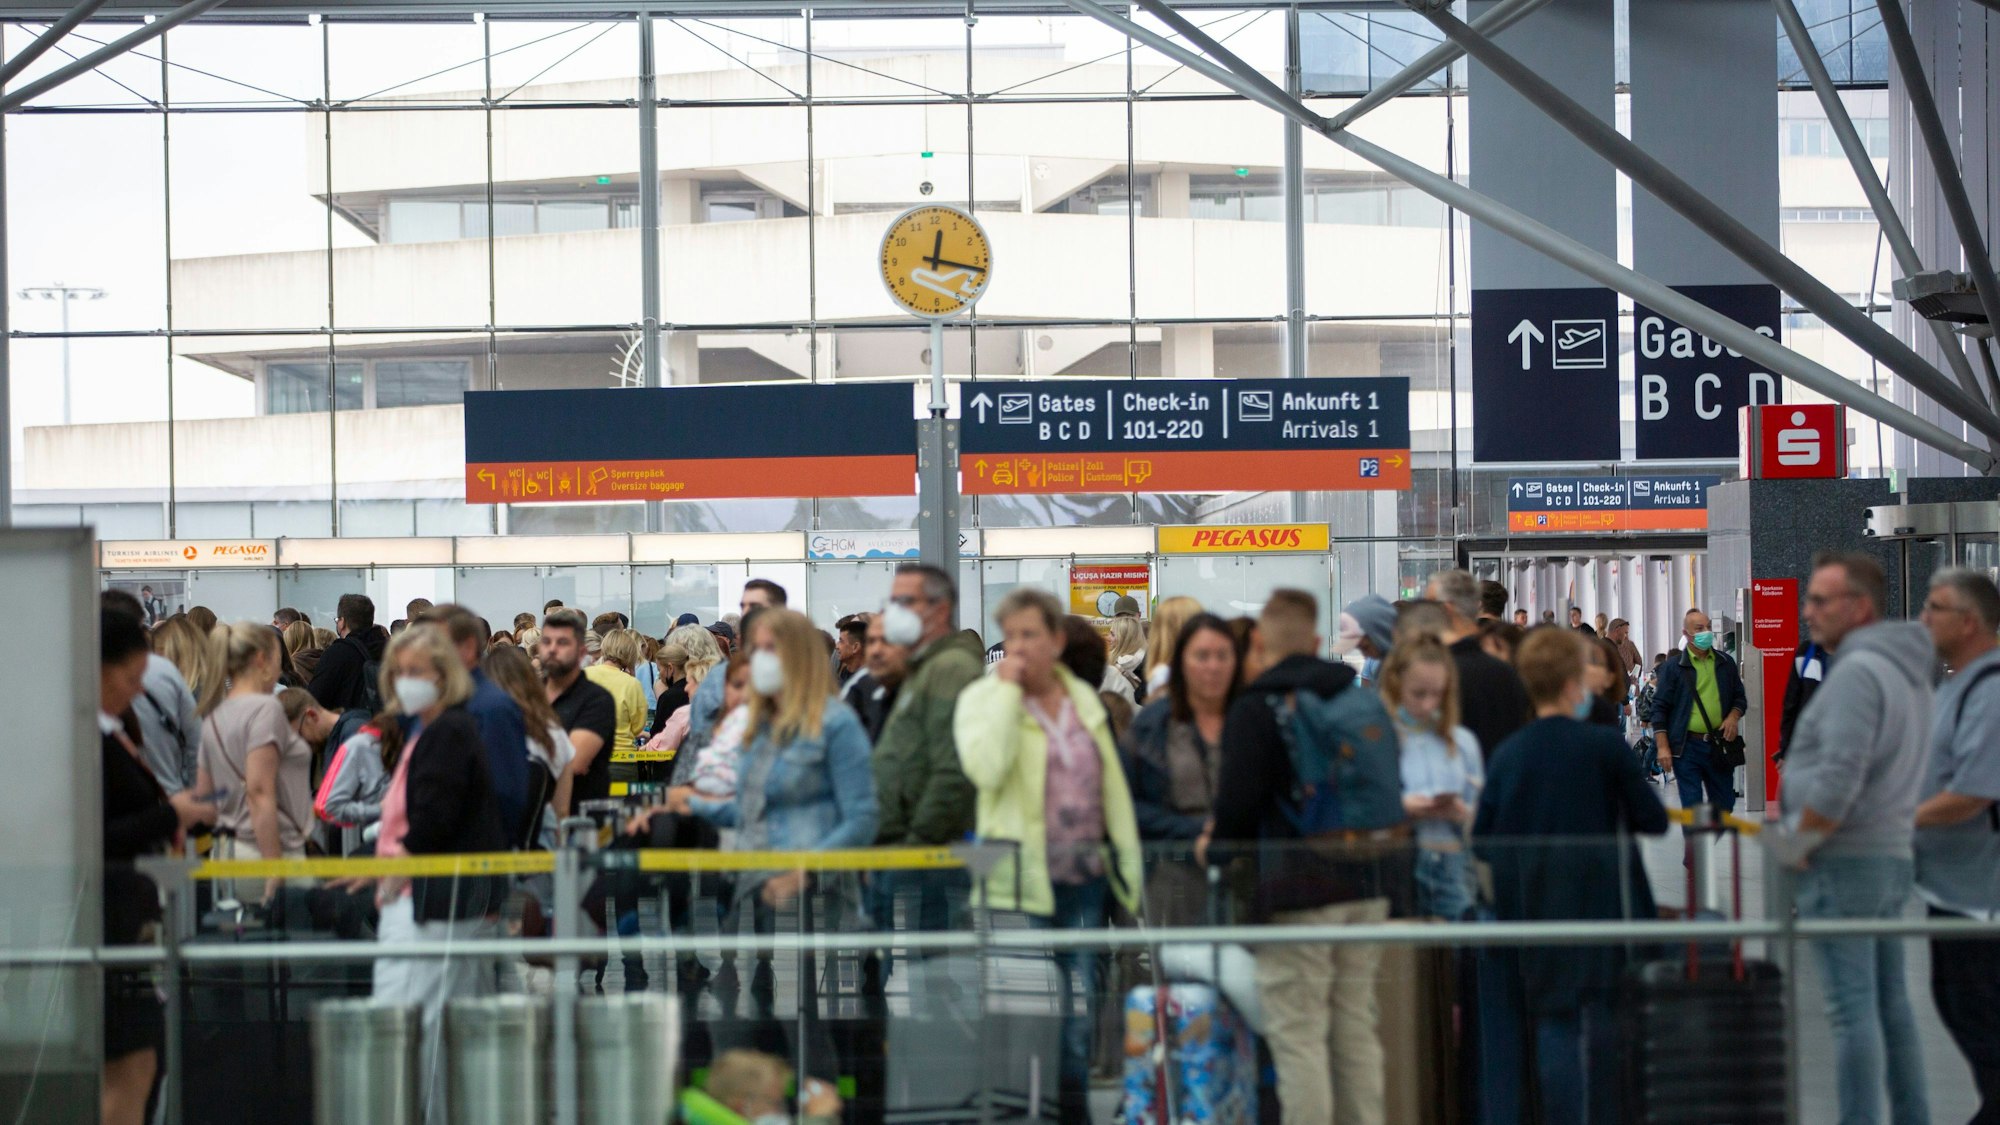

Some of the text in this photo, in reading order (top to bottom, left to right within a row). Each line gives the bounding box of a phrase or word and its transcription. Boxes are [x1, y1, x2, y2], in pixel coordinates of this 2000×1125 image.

[930, 216, 940, 224] 12
[910, 223, 922, 232] 11
[953, 222, 958, 231] 1
[896, 237, 907, 247] 10
[967, 237, 973, 246] 2
[892, 257, 898, 266] 9
[973, 256, 979, 265] 3
[899, 277, 905, 286] 8
[967, 274, 973, 283] 4
[912, 293, 918, 301] 7
[955, 292, 960, 301] 5
[934, 297, 940, 306] 6
[1123, 392, 1209, 411] Check-in
[1282, 392, 1379, 410] Ankunft 1
[1642, 374, 1669, 421] B
[1695, 373, 1722, 420] C
[1039, 394, 1096, 412] Gates
[1039, 421, 1091, 440] B C D
[1123, 420, 1203, 439] 101-220
[1282, 420, 1379, 438] Arrivals 1
[1047, 462, 1079, 471] Polizei
[1086, 462, 1104, 470] Zoll
[509, 469, 522, 478] WC
[536, 471, 549, 480] WC
[611, 469, 665, 480] Sperrgepäck
[1047, 473, 1074, 482] Police
[1086, 472, 1122, 481] Customs
[611, 481, 685, 492] Oversize baggage
[1546, 483, 1573, 492] Gates
[1583, 482, 1625, 492] Check-in
[1654, 481, 1700, 491] Ankunft 1
[1546, 496, 1571, 505] B C D
[1583, 496, 1621, 505] 101-220
[1654, 494, 1700, 504] Arrivals 1
[1192, 528, 1302, 547] PEGASUS
[213, 545, 269, 555] PEGASUS
